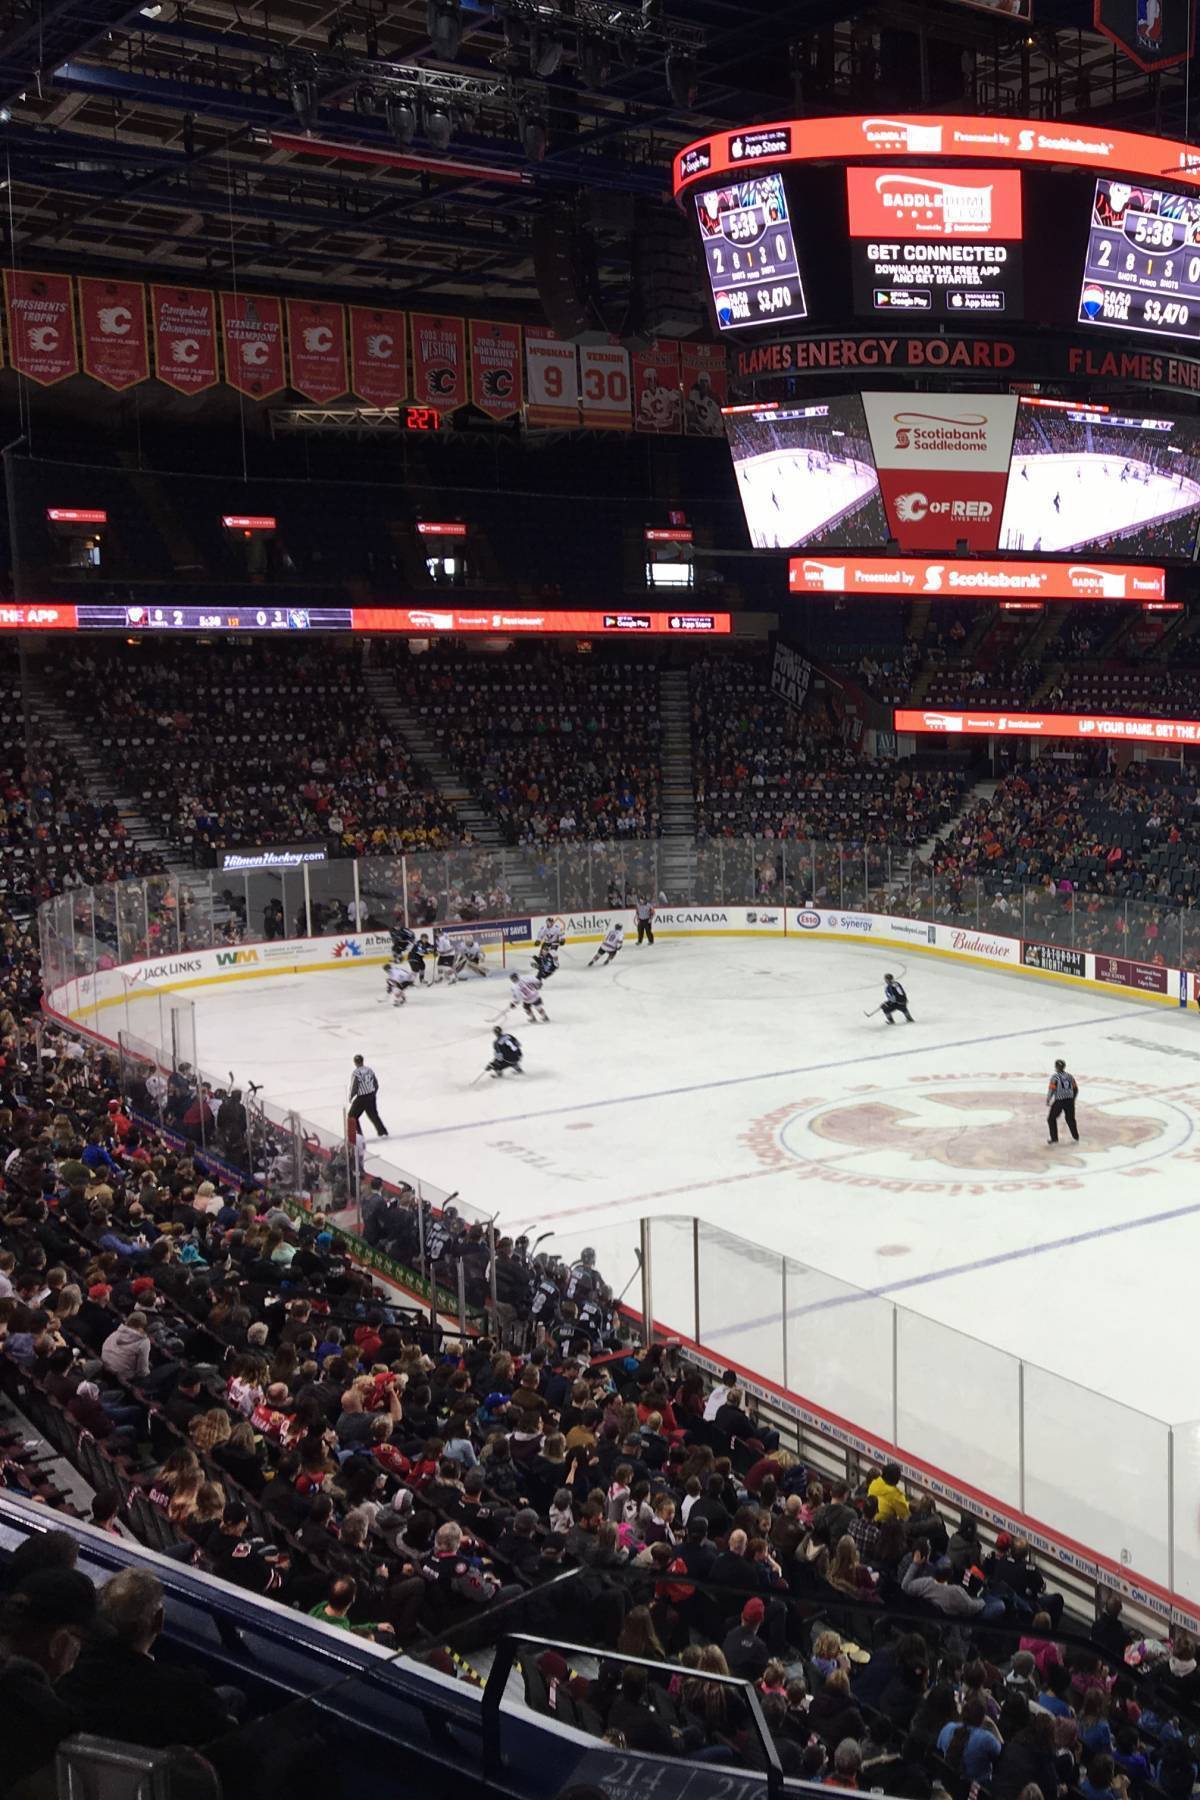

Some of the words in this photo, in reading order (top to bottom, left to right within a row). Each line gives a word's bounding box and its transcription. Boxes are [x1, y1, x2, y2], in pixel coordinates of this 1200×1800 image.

[745, 142, 763, 157] App
[763, 140, 788, 154] Store
[729, 210, 758, 240] 5:38
[1134, 216, 1175, 247] 5:38
[712, 248, 725, 274] 2
[732, 252, 741, 270] 8
[759, 246, 768, 264] 3
[775, 234, 787, 262] 0
[867, 244, 901, 260] GET
[903, 245, 1007, 262] CONNECTED
[1097, 240, 1112, 268] 2
[1125, 252, 1136, 271] 8
[1146, 259, 1153, 275] 1
[1164, 260, 1174, 277] 3
[875, 264, 932, 275] DOWNLOAD
[932, 265, 952, 275] THE
[953, 266, 979, 276] FREE
[979, 266, 1000, 276] APP
[893, 274, 914, 284] AND
[915, 274, 935, 284] GET
[936, 274, 983, 285] STARTED.
[757, 286, 792, 313] $3,470
[965, 298, 980, 308] App
[980, 298, 1000, 308] Store
[1104, 290, 1132, 307] 50/50
[22, 312, 60, 323] TROPHY
[160, 302, 209, 318] Campbell
[1103, 303, 1129, 320] TOTAL
[1143, 299, 1189, 326] $3,470
[159, 322, 212, 337] Champions
[421, 341, 457, 366] WESTERN
[474, 345, 519, 360] NORTHWEST
[586, 351, 624, 363] VERNON
[738, 344, 792, 376] FLAMES
[796, 338, 899, 368] ENERGY
[906, 339, 1017, 370] BOARD
[1068, 347, 1164, 383] FLAMES
[543, 364, 563, 398] 9
[585, 367, 628, 402] 30
[914, 427, 987, 441] Scotiabank
[914, 440, 988, 451] Saddledome
[929, 501, 950, 514] OF
[951, 500, 993, 517] RED
[855, 569, 900, 584] Presented
[902, 571, 915, 586] by
[949, 571, 1042, 589] Scotiabank
[26, 609, 59, 624] APP
[173, 611, 184, 625] 2
[256, 611, 267, 625] 0
[273, 610, 283, 621] 3
[681, 621, 695, 630] App
[695, 621, 712, 629] Store
[774, 651, 811, 692] POWER
[771, 669, 808, 706] PLAY
[1078, 721, 1094, 733] UP
[1096, 722, 1125, 735] YOUR
[1156, 725, 1175, 739] GET
[1176, 726, 1195, 739] THE
[222, 851, 325, 870] HitmenHockey.com
[566, 914, 612, 932] Ashley
[655, 913, 675, 924] AIR
[676, 911, 728, 924] CANADA
[800, 914, 818, 925] Esso
[840, 917, 873, 932] Synergy
[509, 925, 529, 936] SAVES
[951, 930, 1010, 959] Budweiser
[215, 949, 260, 967] WM
[1041, 945, 1082, 966] SATURDAY
[143, 966, 168, 981] JACK
[601, 1757, 667, 1792] 214
